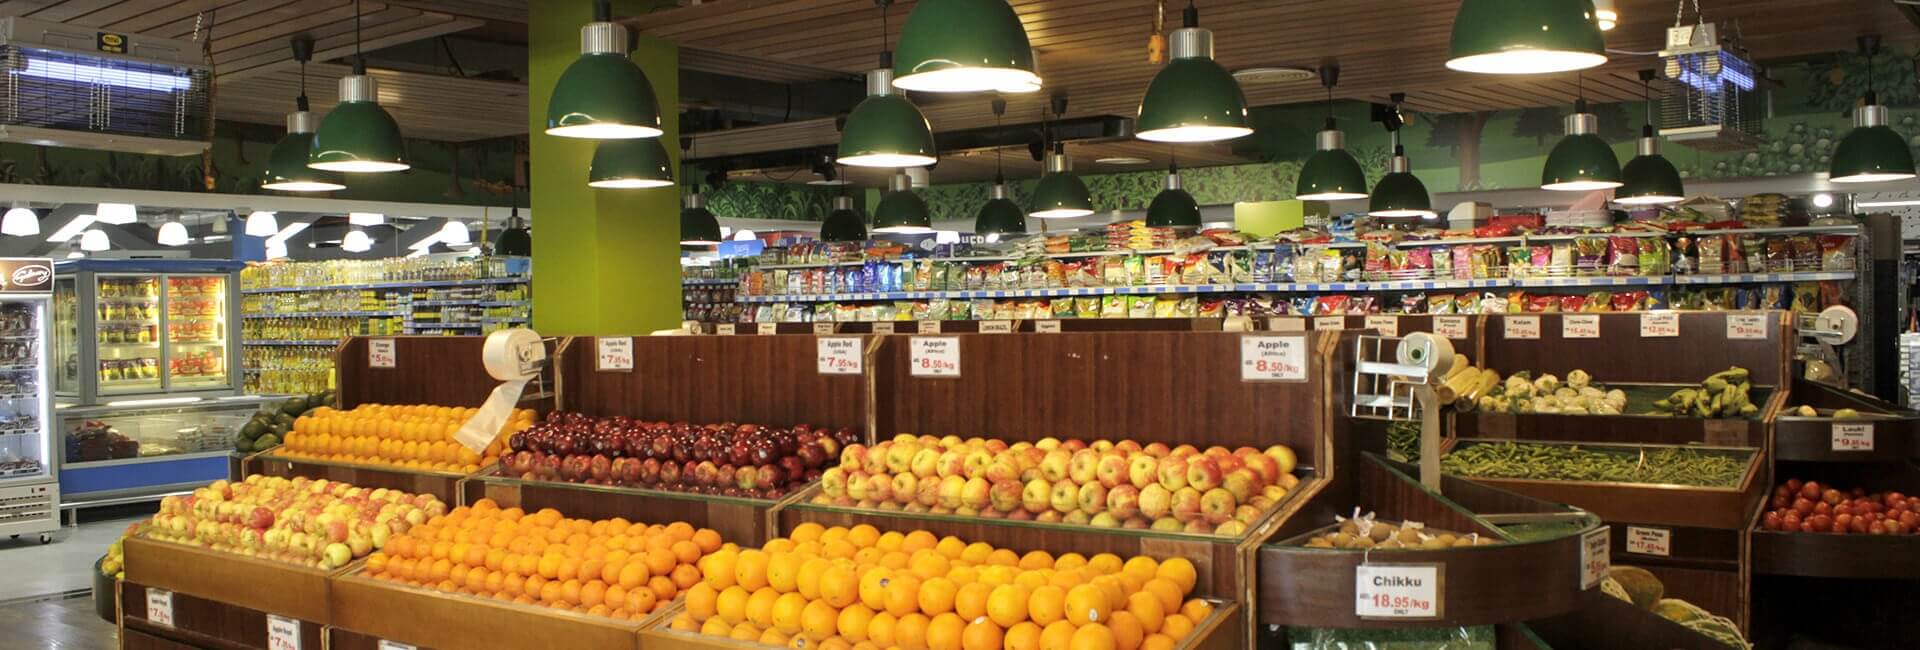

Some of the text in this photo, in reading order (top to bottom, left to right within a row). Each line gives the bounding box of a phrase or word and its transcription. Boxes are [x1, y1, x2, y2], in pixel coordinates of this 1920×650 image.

[922, 340, 947, 348] Apple
[1258, 340, 1290, 349] Apple
[1373, 575, 1422, 587] Chikku
[1372, 593, 1430, 610] 18.95/kg
